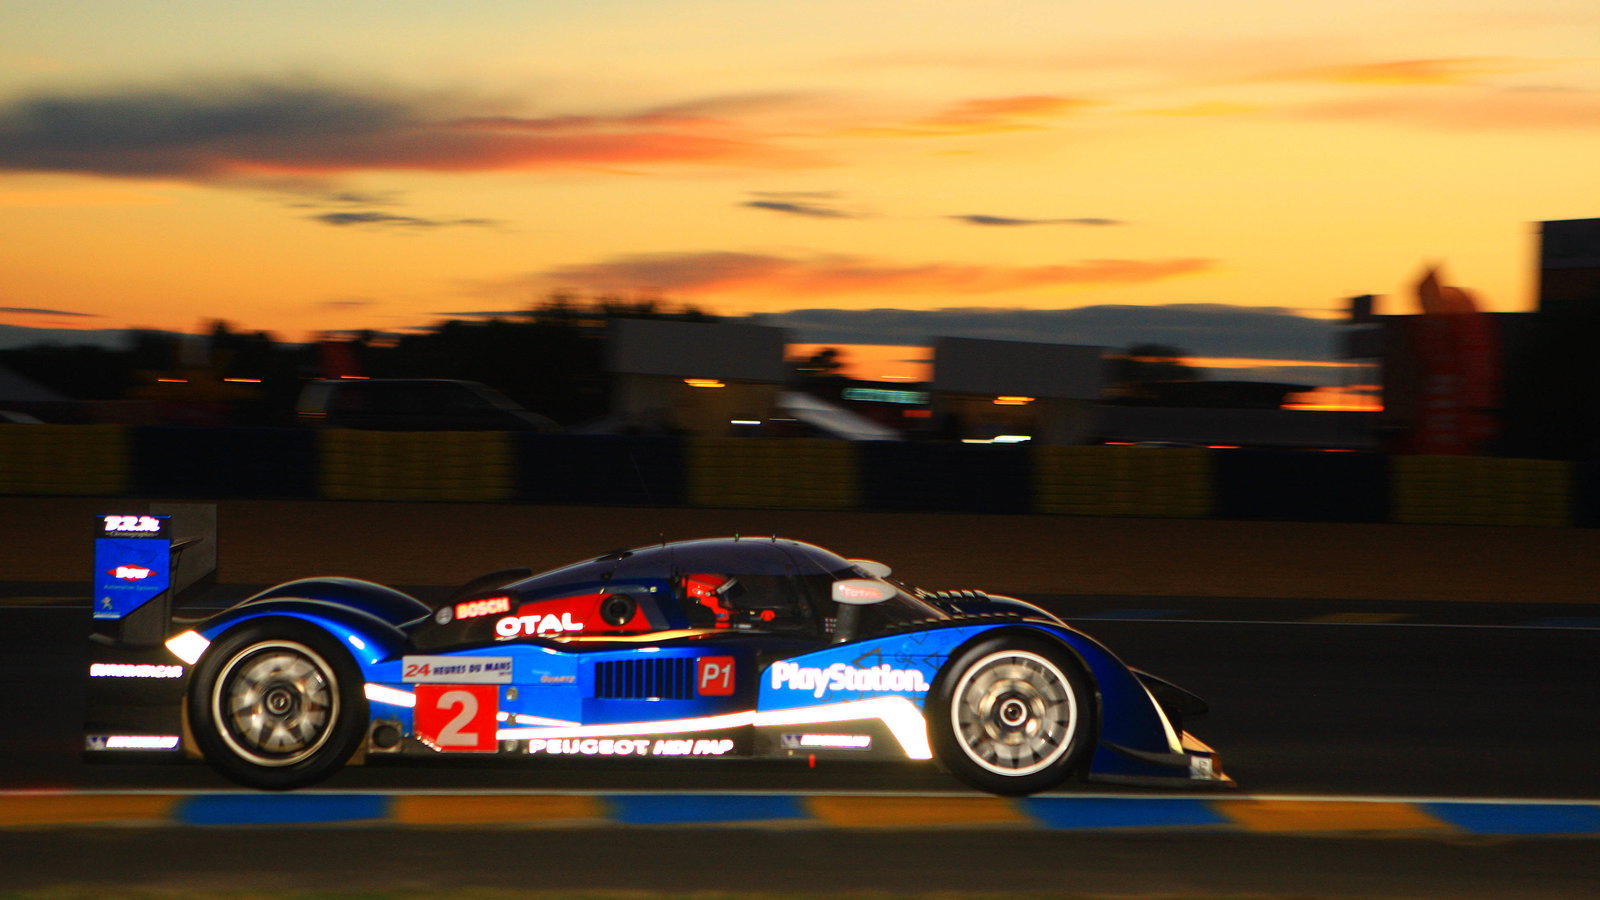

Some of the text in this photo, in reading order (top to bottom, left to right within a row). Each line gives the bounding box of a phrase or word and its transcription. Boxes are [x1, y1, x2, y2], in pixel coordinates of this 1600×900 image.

[455, 597, 510, 619] BOSCH
[404, 661, 511, 678] 24 HEURES DU MANS
[701, 663, 730, 689] P1
[435, 690, 479, 747] 2
[528, 739, 650, 755] PEUGEOT
